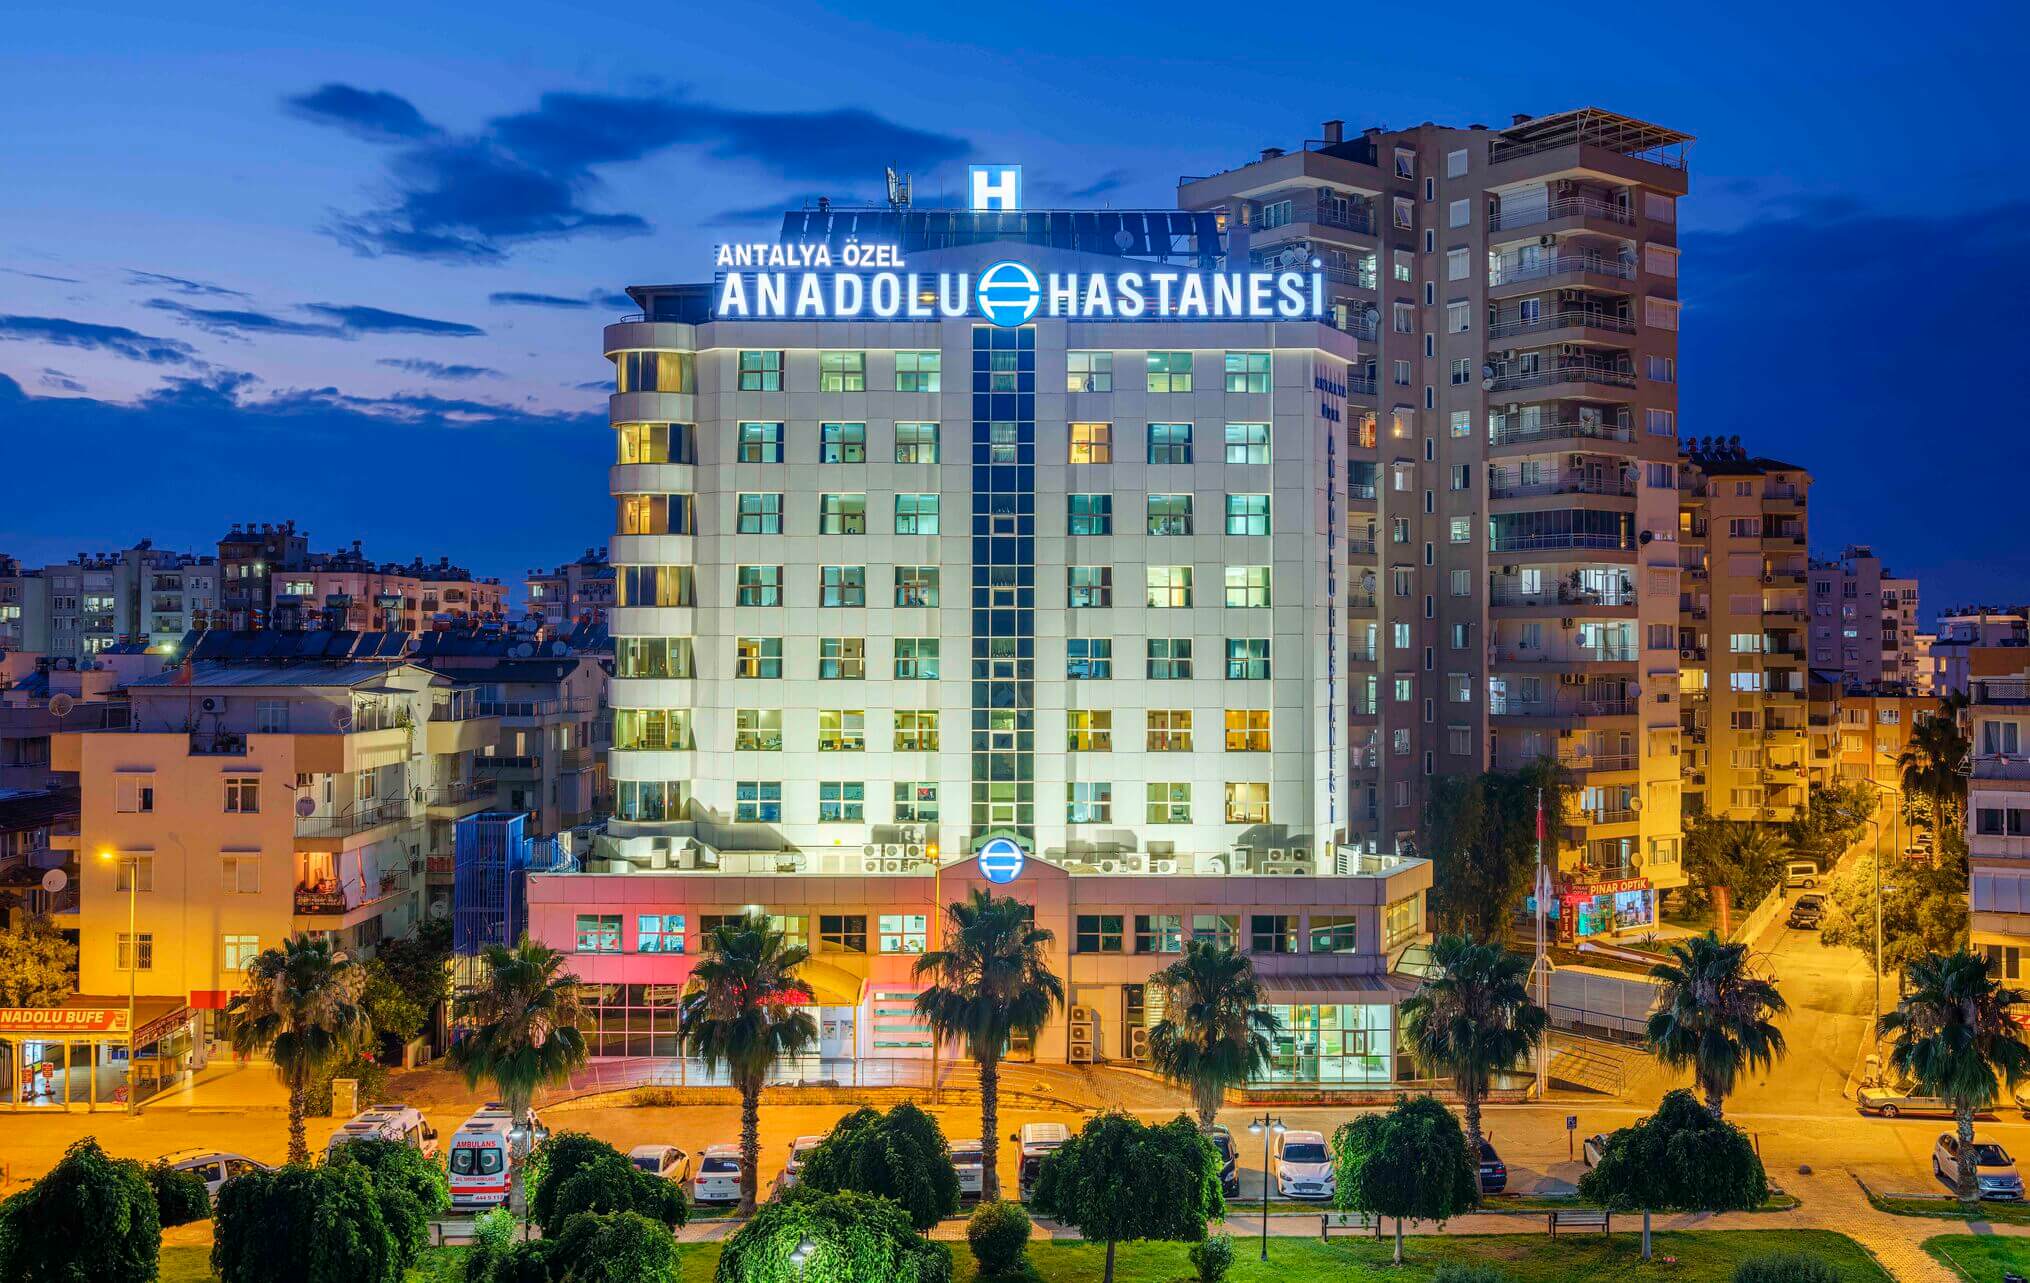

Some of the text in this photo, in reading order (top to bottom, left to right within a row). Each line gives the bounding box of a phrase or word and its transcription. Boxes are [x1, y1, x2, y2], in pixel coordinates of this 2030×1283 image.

[973, 170, 1016, 213] H
[717, 237, 905, 267] ANTALYA ÖZEL
[718, 259, 1323, 317] ANADOLU HASTANESİ
[1590, 883, 1617, 895] PINAR
[0, 1011, 63, 1023] NADOLU
[456, 1140, 497, 1148] AMBULANS
